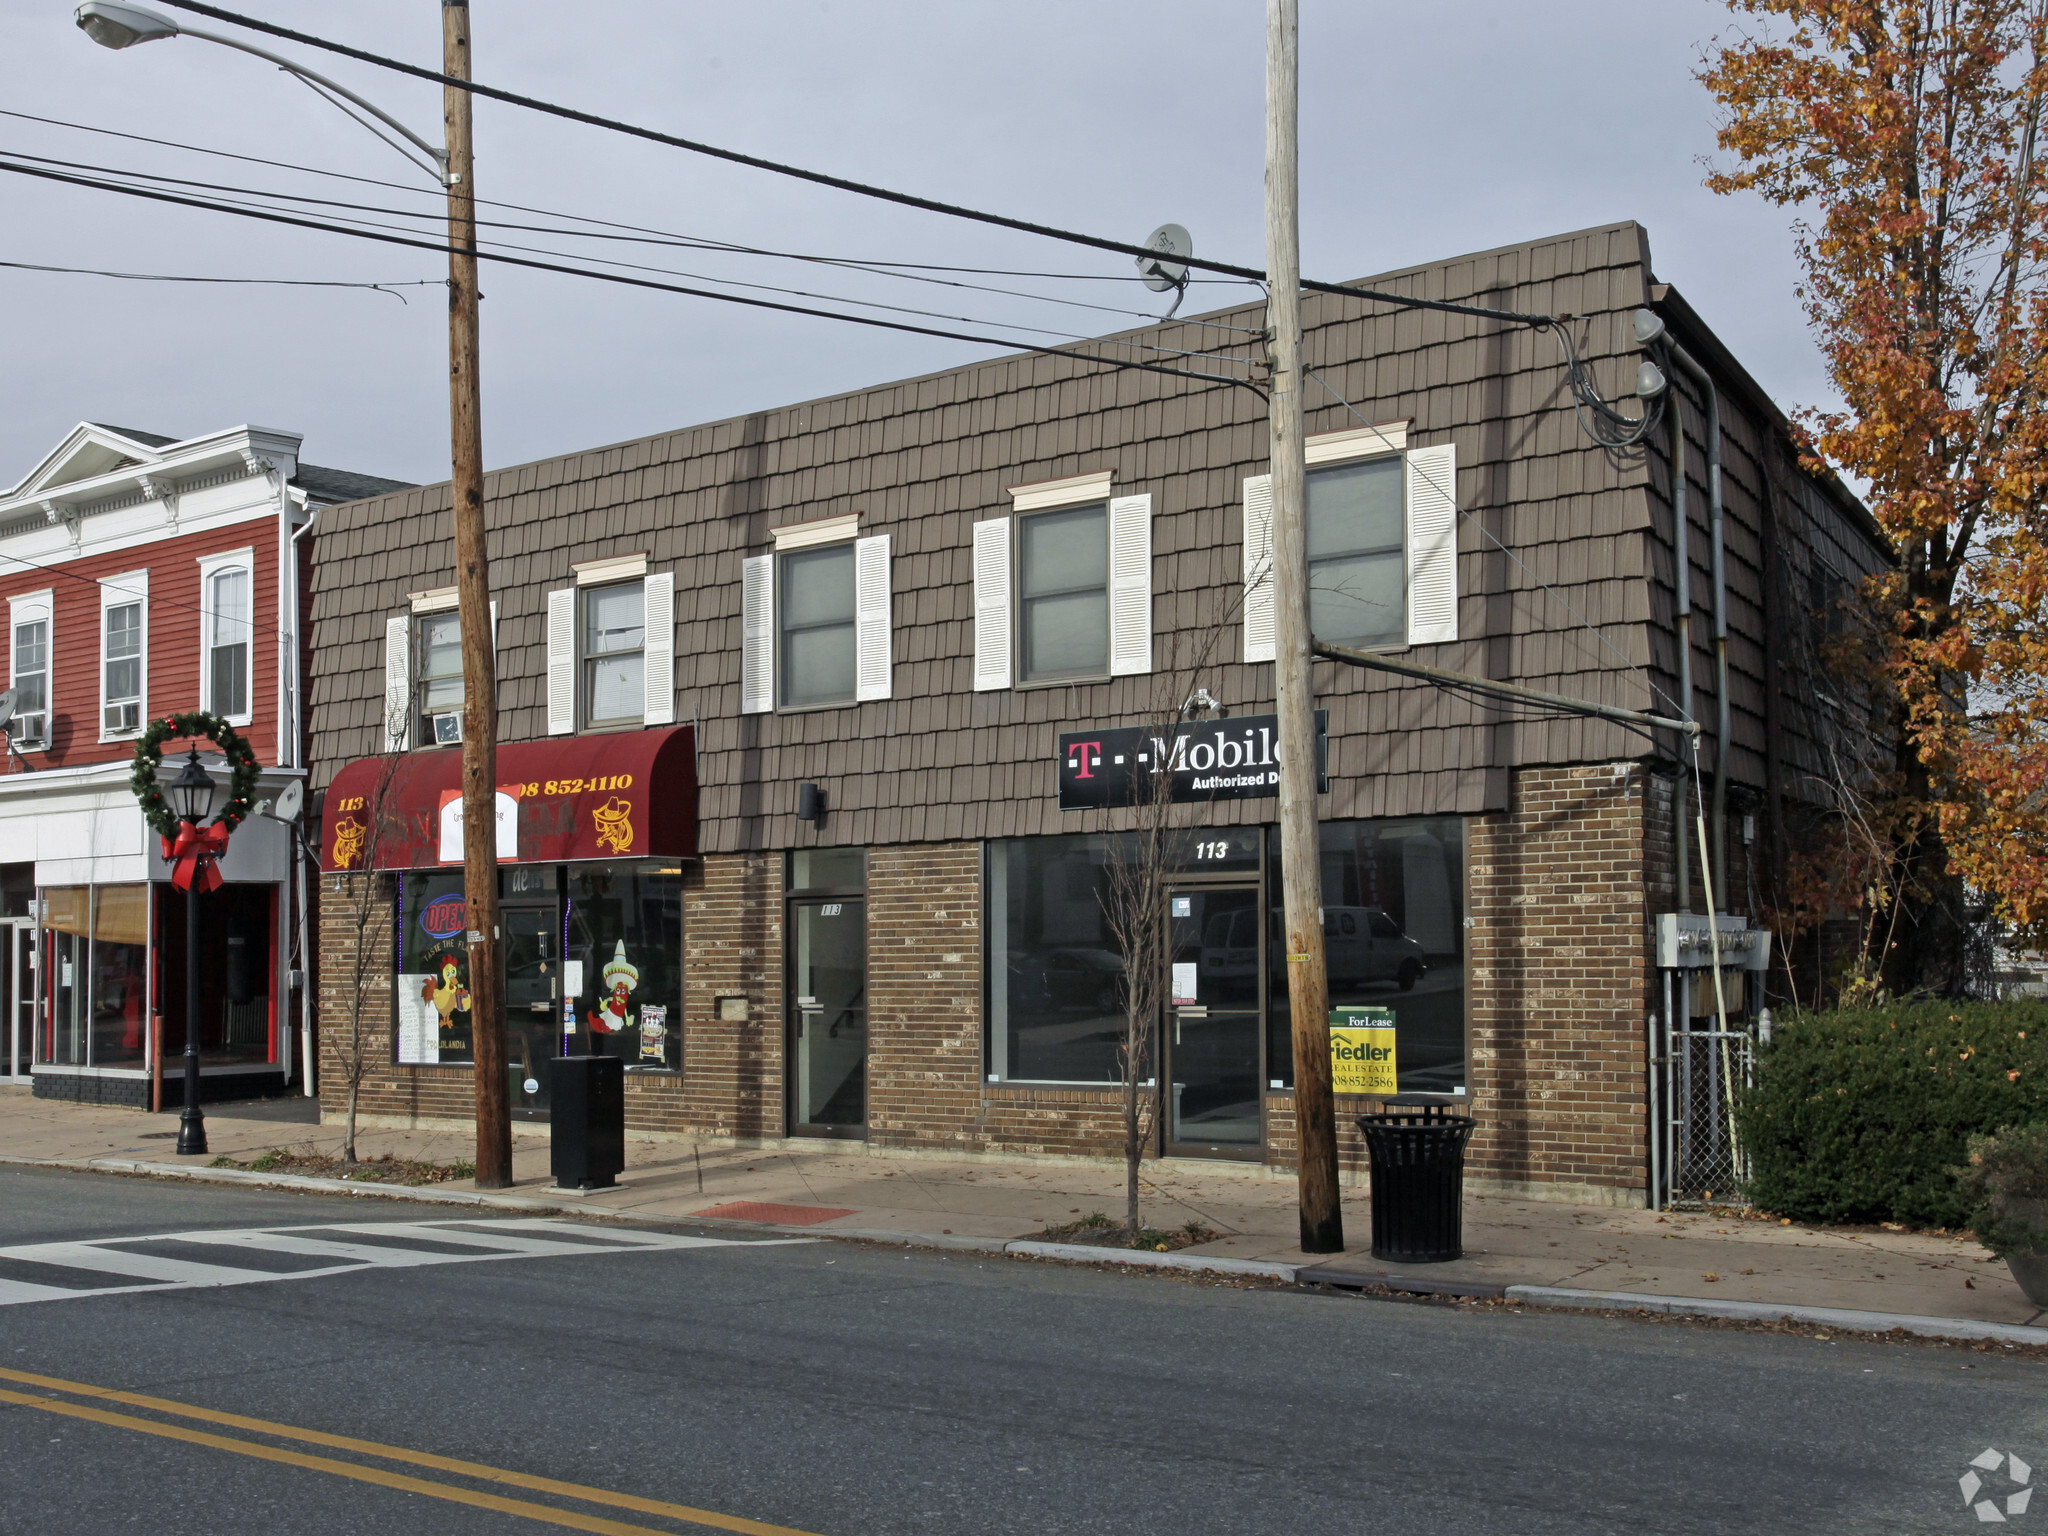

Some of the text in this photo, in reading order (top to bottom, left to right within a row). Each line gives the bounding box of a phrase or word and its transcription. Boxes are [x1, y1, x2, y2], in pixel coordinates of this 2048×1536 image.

[544, 774, 633, 796] 852-1110
[1192, 772, 1280, 790] Authorized D
[338, 796, 364, 812] 113
[1196, 842, 1229, 859] 113
[425, 903, 468, 932] OPEN
[823, 904, 842, 915] 113
[423, 942, 442, 962] TASTE
[442, 938, 455, 949] THE
[1348, 1016, 1393, 1027] For Lease
[1330, 1042, 1392, 1061] iedler
[1331, 1064, 1354, 1073] EAL
